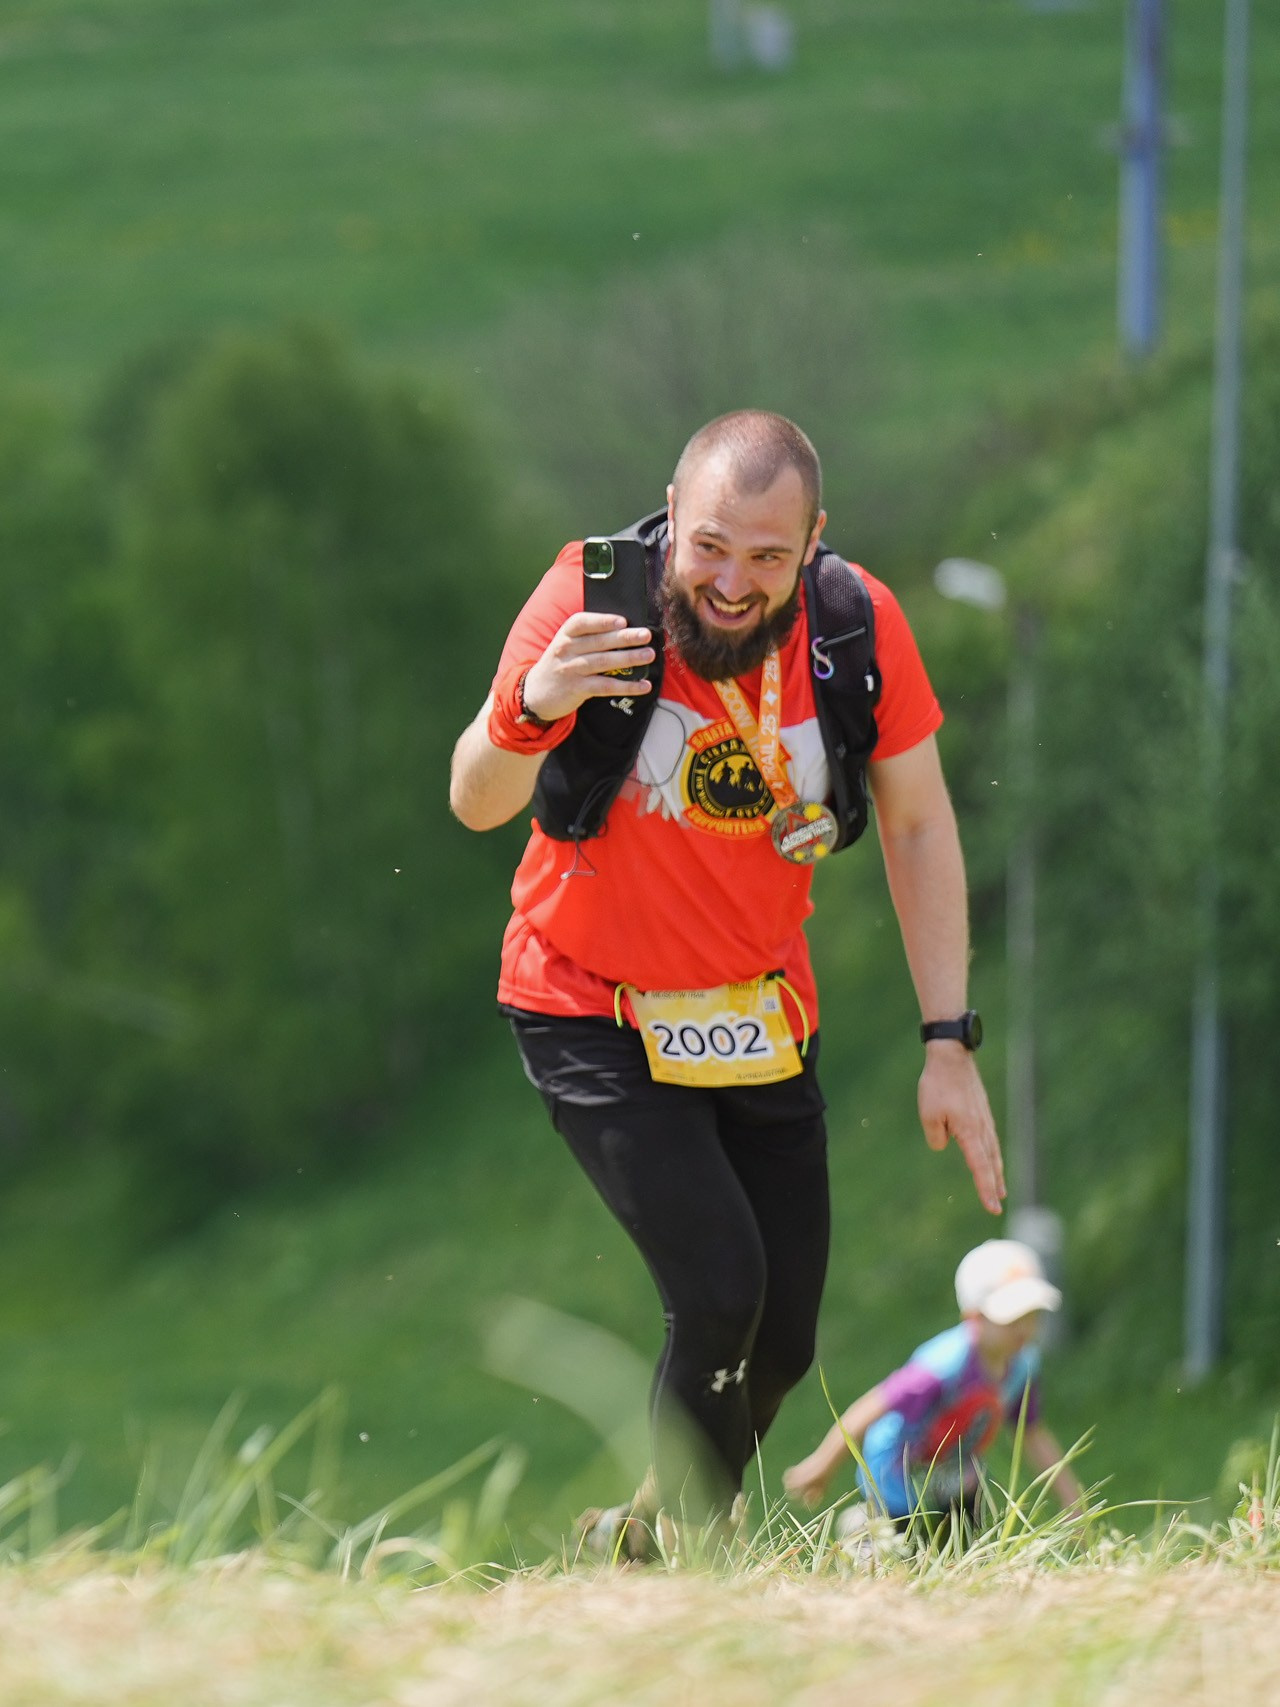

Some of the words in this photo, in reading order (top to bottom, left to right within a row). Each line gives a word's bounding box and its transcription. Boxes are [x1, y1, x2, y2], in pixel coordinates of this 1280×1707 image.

[691, 722, 735, 748] SPARTA
[760, 713, 777, 736] 25
[652, 1022, 768, 1057] 2002
